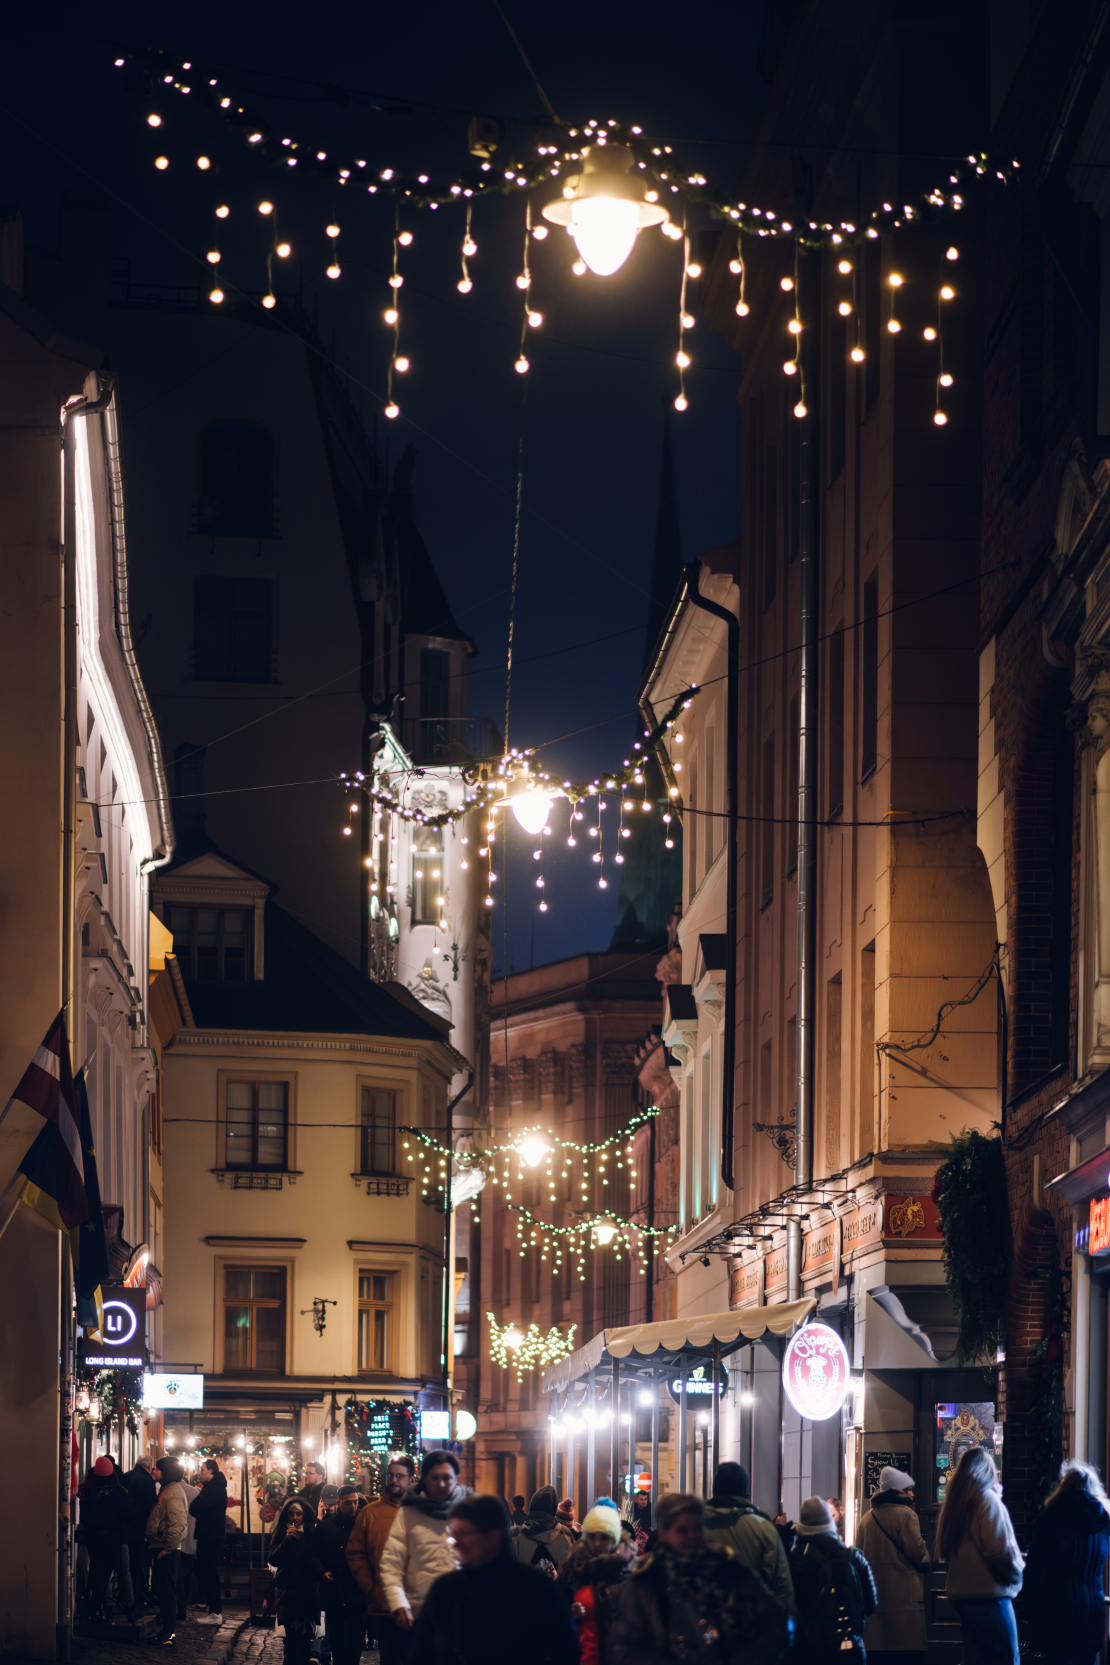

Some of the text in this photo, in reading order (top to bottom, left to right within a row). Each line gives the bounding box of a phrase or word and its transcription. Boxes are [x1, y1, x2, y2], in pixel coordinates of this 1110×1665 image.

[107, 1315, 122, 1331] LI
[85, 1357, 143, 1366] LONG ISLAND BAR
